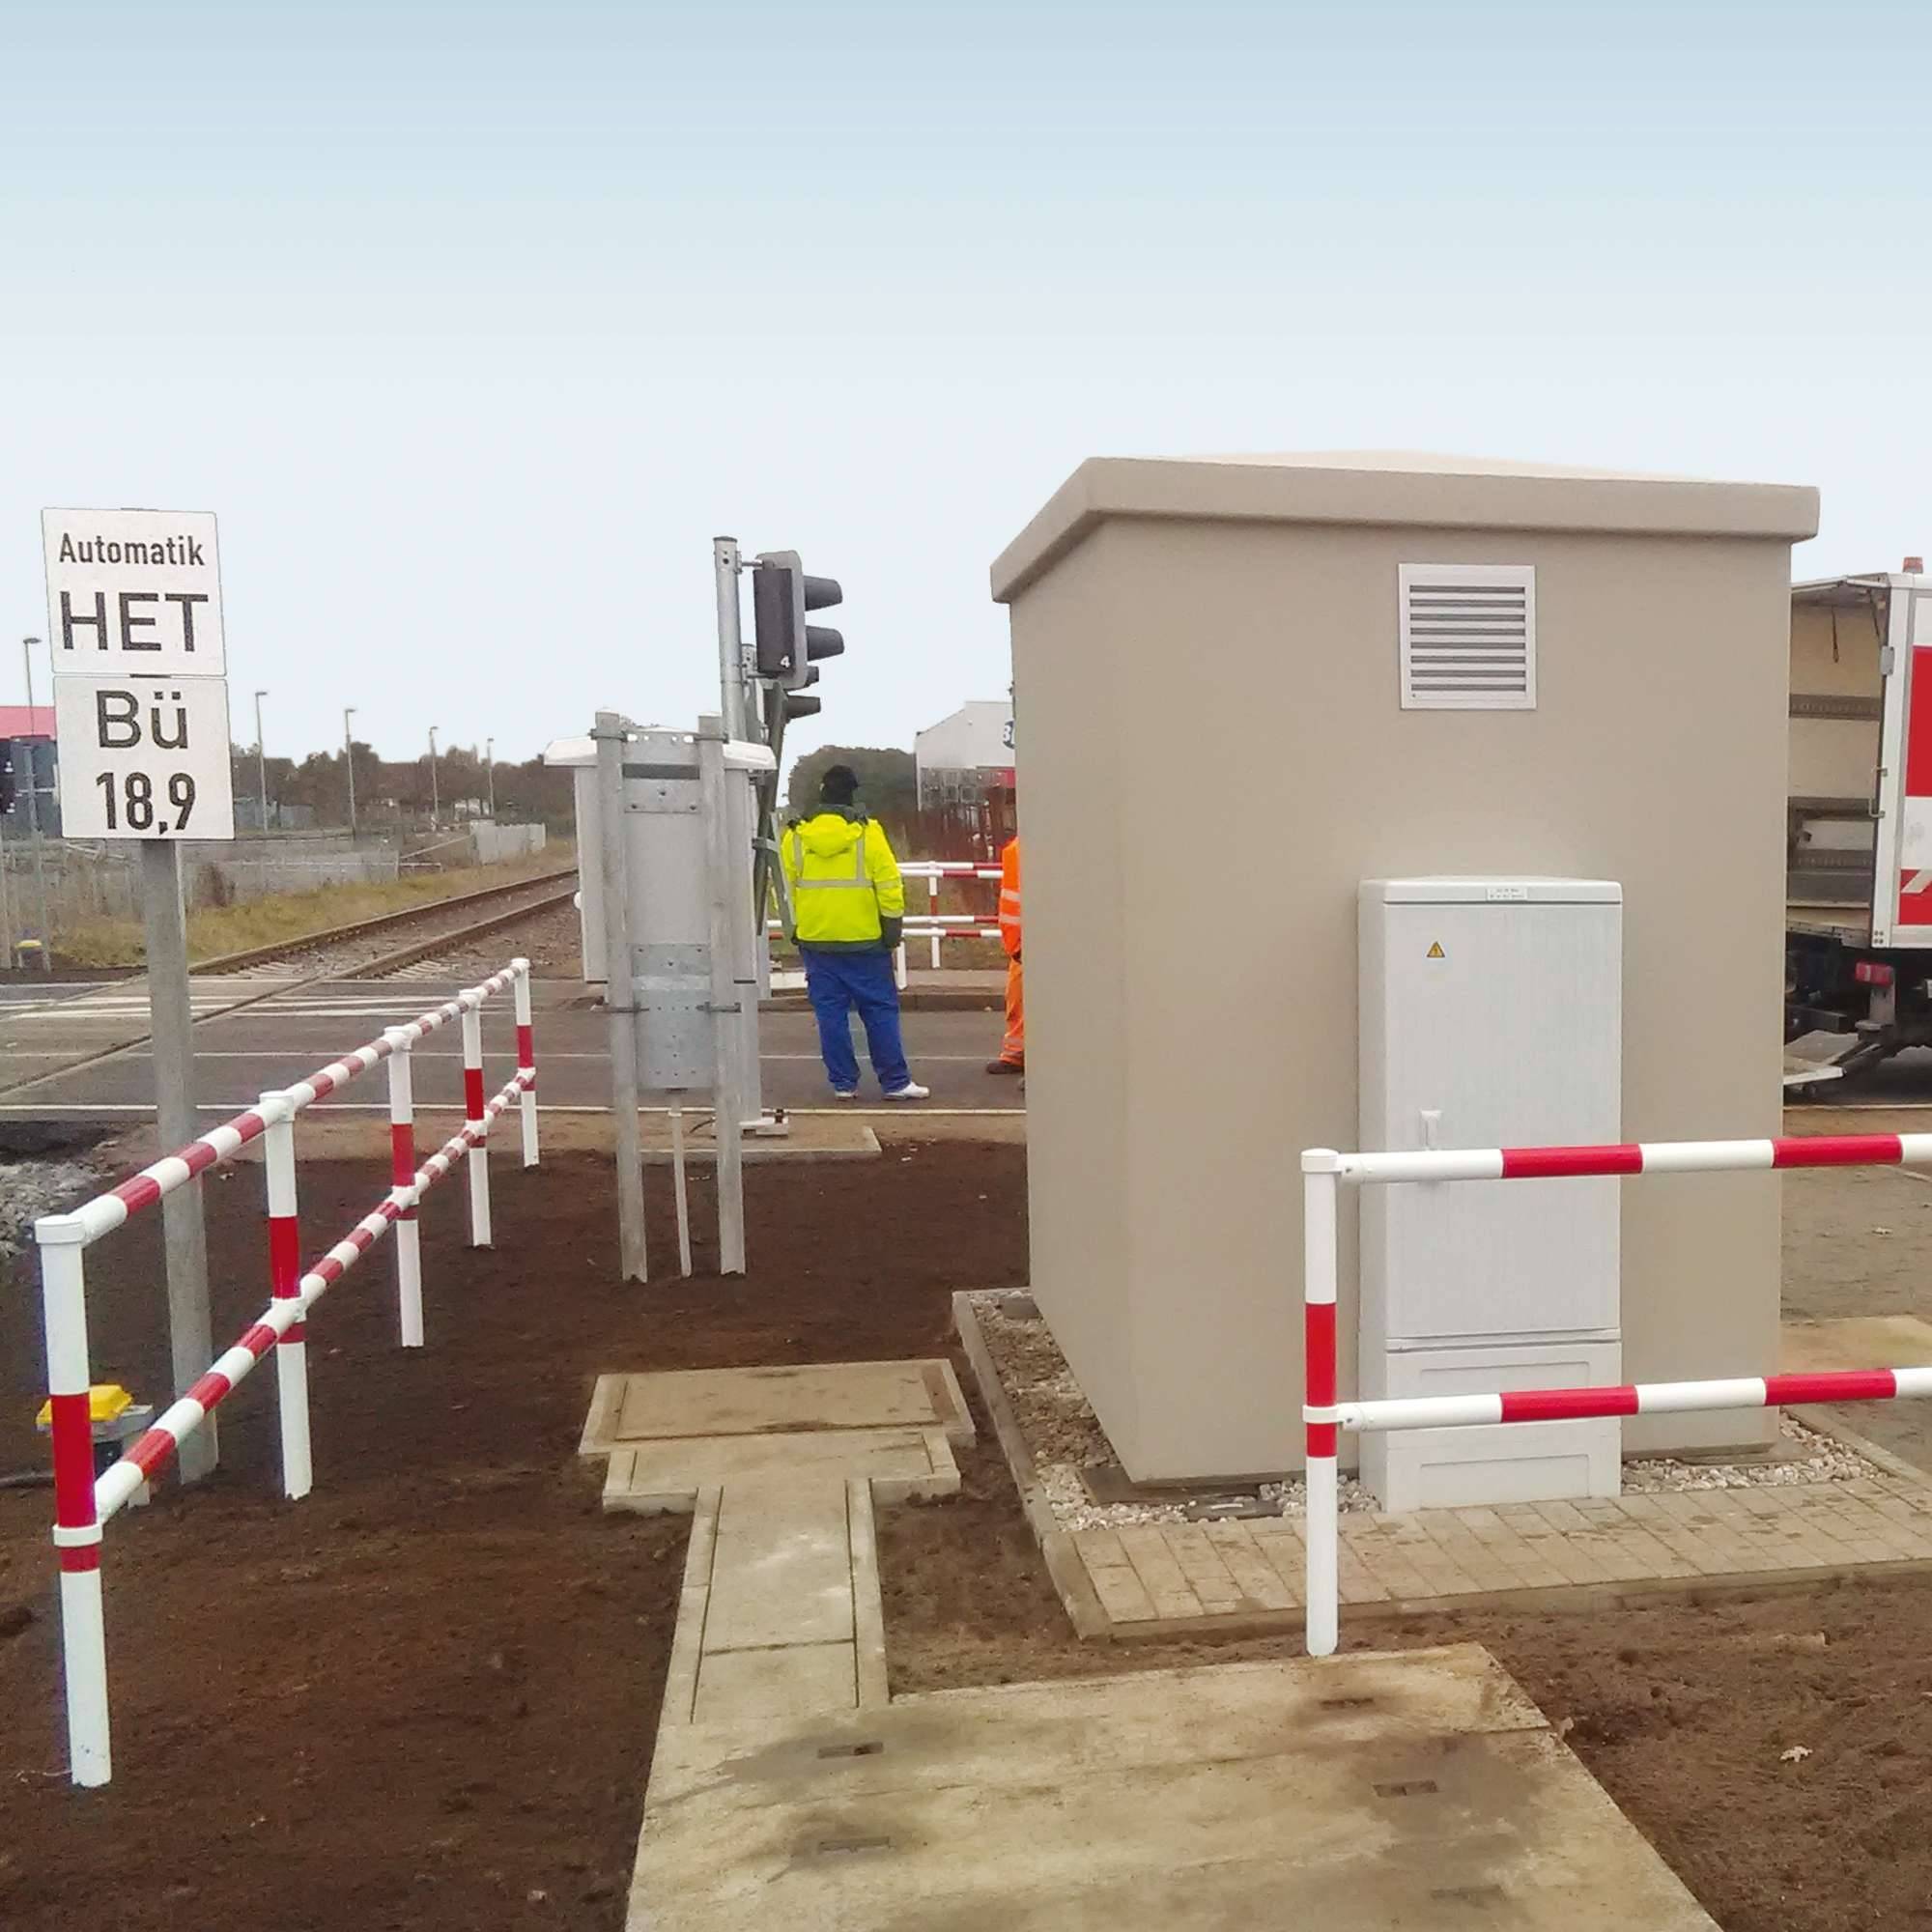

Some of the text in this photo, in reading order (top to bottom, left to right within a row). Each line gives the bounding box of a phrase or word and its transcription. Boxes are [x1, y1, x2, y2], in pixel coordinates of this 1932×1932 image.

[60, 533, 204, 565] Automatik
[61, 591, 208, 651] HET
[97, 691, 187, 749] Bü
[97, 772, 195, 835] 18,9
